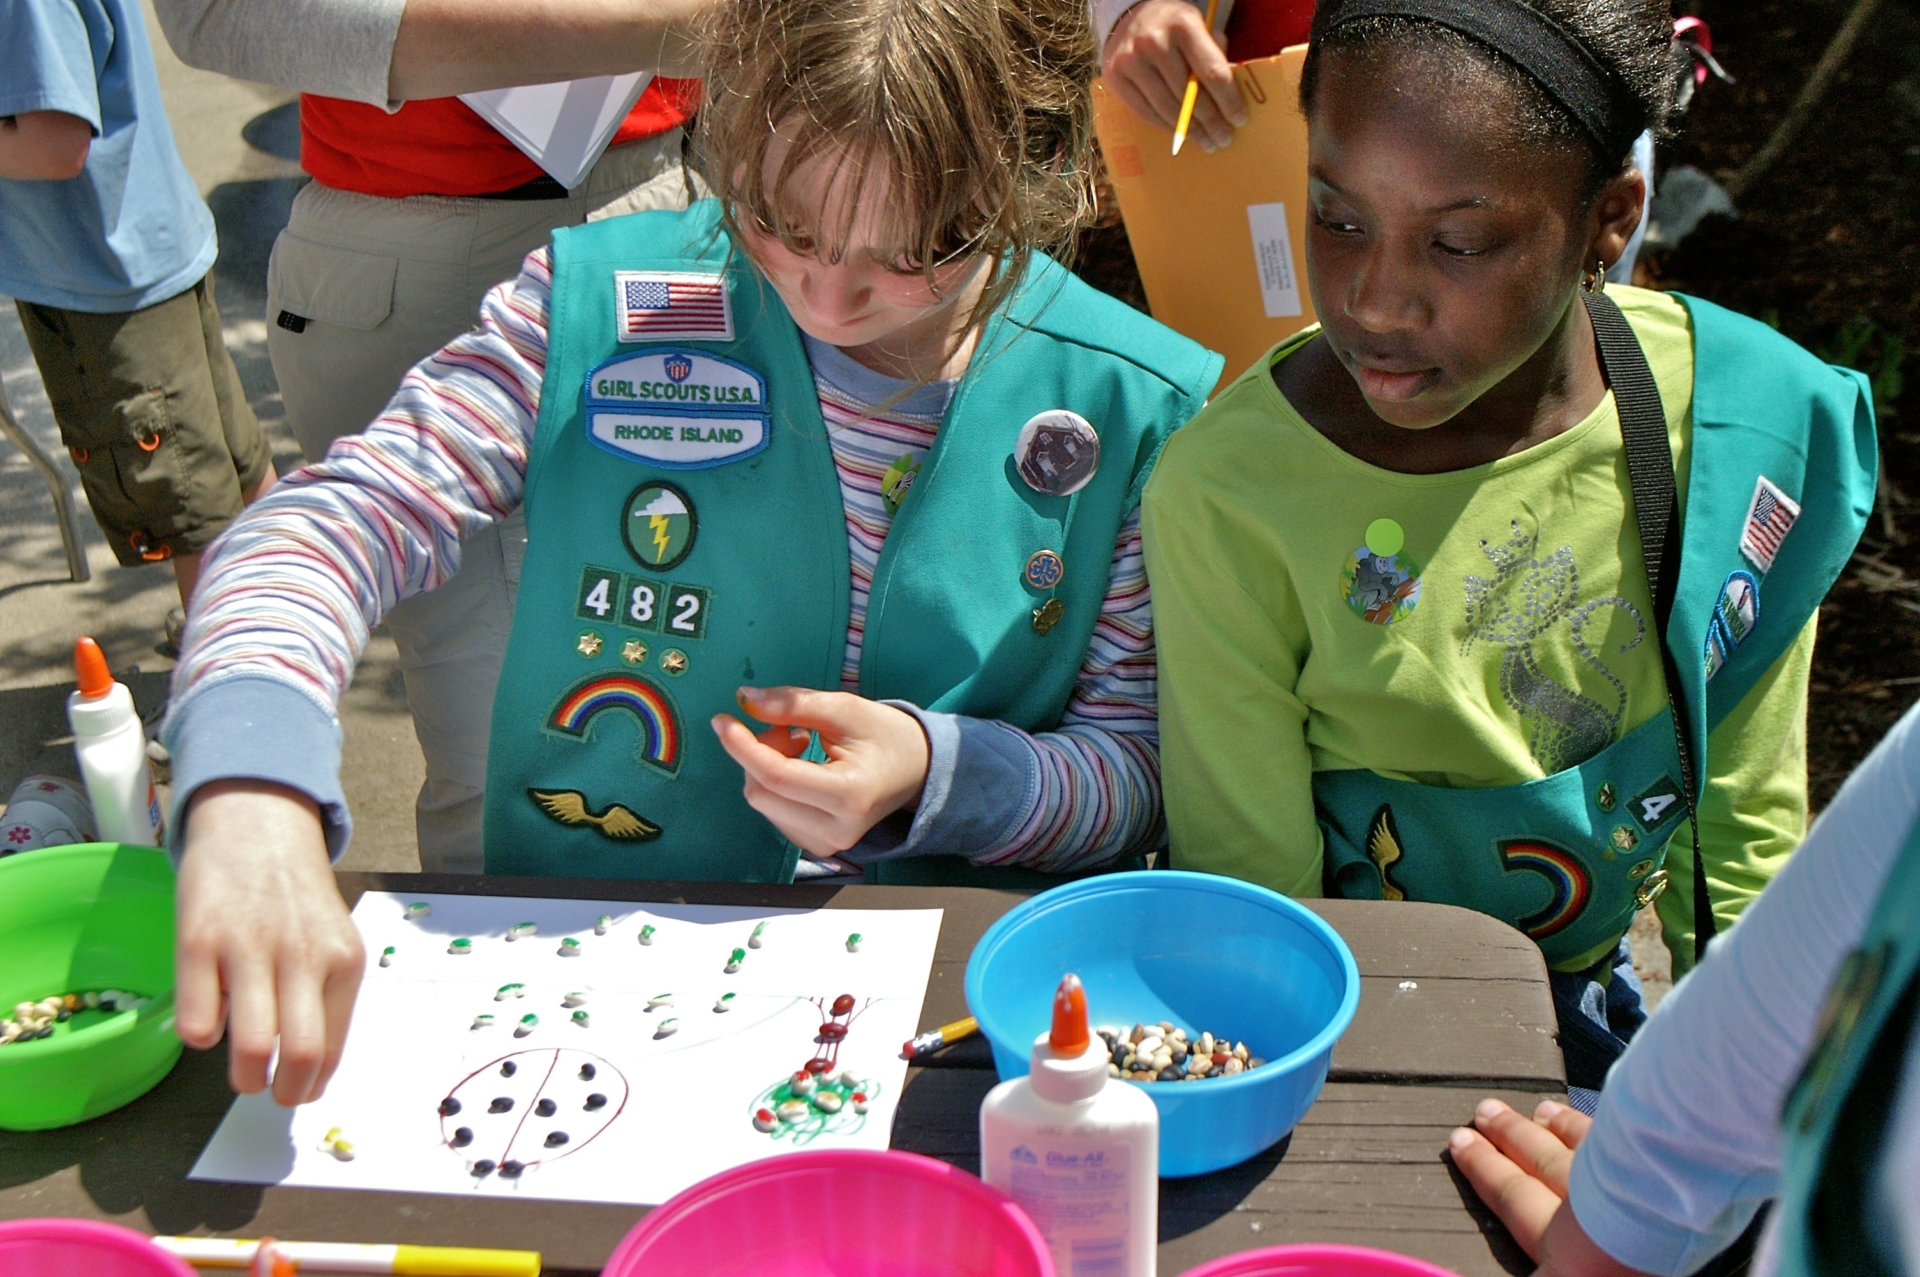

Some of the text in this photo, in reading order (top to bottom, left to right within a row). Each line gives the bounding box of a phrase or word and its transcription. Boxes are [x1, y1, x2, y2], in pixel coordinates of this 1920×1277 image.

[597, 379, 636, 399] GIRL
[639, 380, 711, 402] SCOUTS
[614, 424, 743, 444] RHODE ISLAND
[1640, 793, 1677, 822] 4
